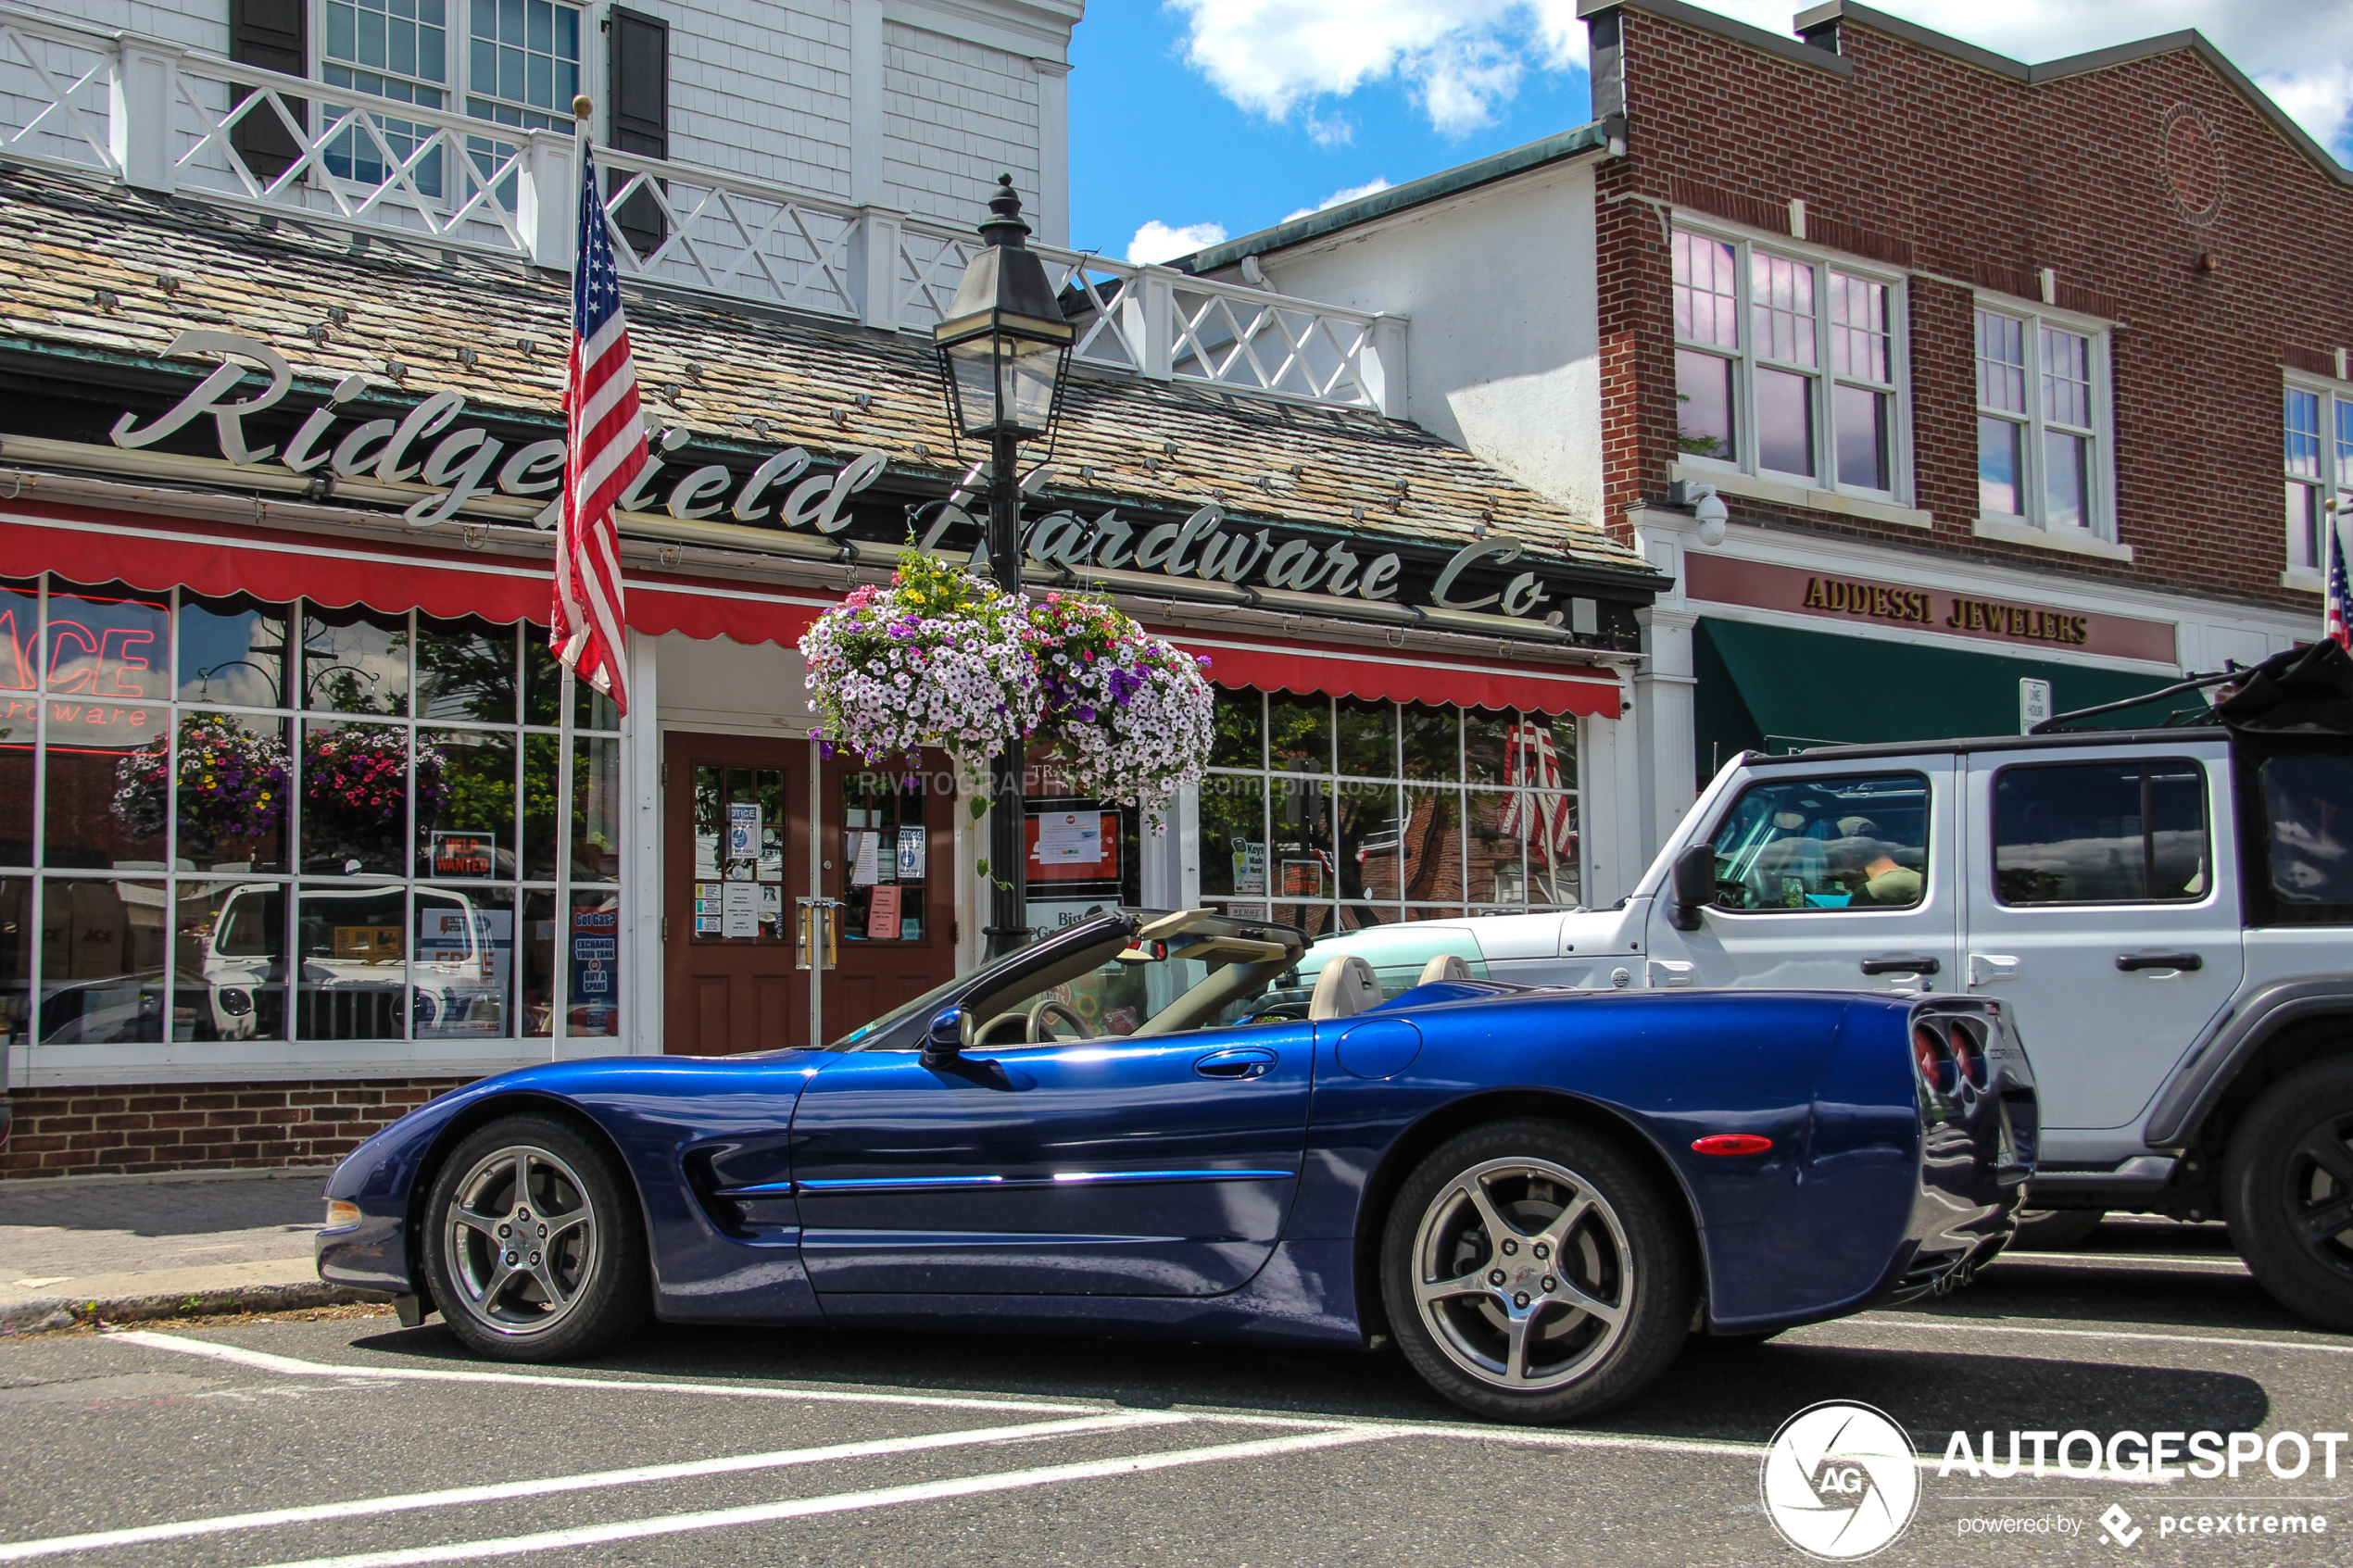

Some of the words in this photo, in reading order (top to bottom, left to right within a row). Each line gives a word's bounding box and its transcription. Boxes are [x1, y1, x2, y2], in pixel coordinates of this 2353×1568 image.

[108, 330, 887, 533] Ridgeield
[1804, 577, 1934, 623] ADDESSI
[1947, 598, 2088, 644] JEWELERS
[2029, 689, 2041, 702] ONE
[2027, 704, 2044, 718] HOUR
[445, 838, 479, 854] HELP
[1248, 844, 1265, 857] Keys
[436, 857, 489, 872] WANTED
[1249, 857, 1264, 865] Made
[1291, 866, 1312, 878] HELP
[1285, 880, 1319, 893] WANTED
[575, 912, 591, 926] Got
[593, 912, 616, 926] Gas?
[82, 928, 115, 944] ACE
[576, 939, 614, 949] EXCHANGE
[576, 950, 595, 960] YOUR
[596, 950, 615, 960] TANK
[584, 972, 600, 981] BUY
[600, 972, 607, 981] A
[584, 981, 607, 992] SPARE
